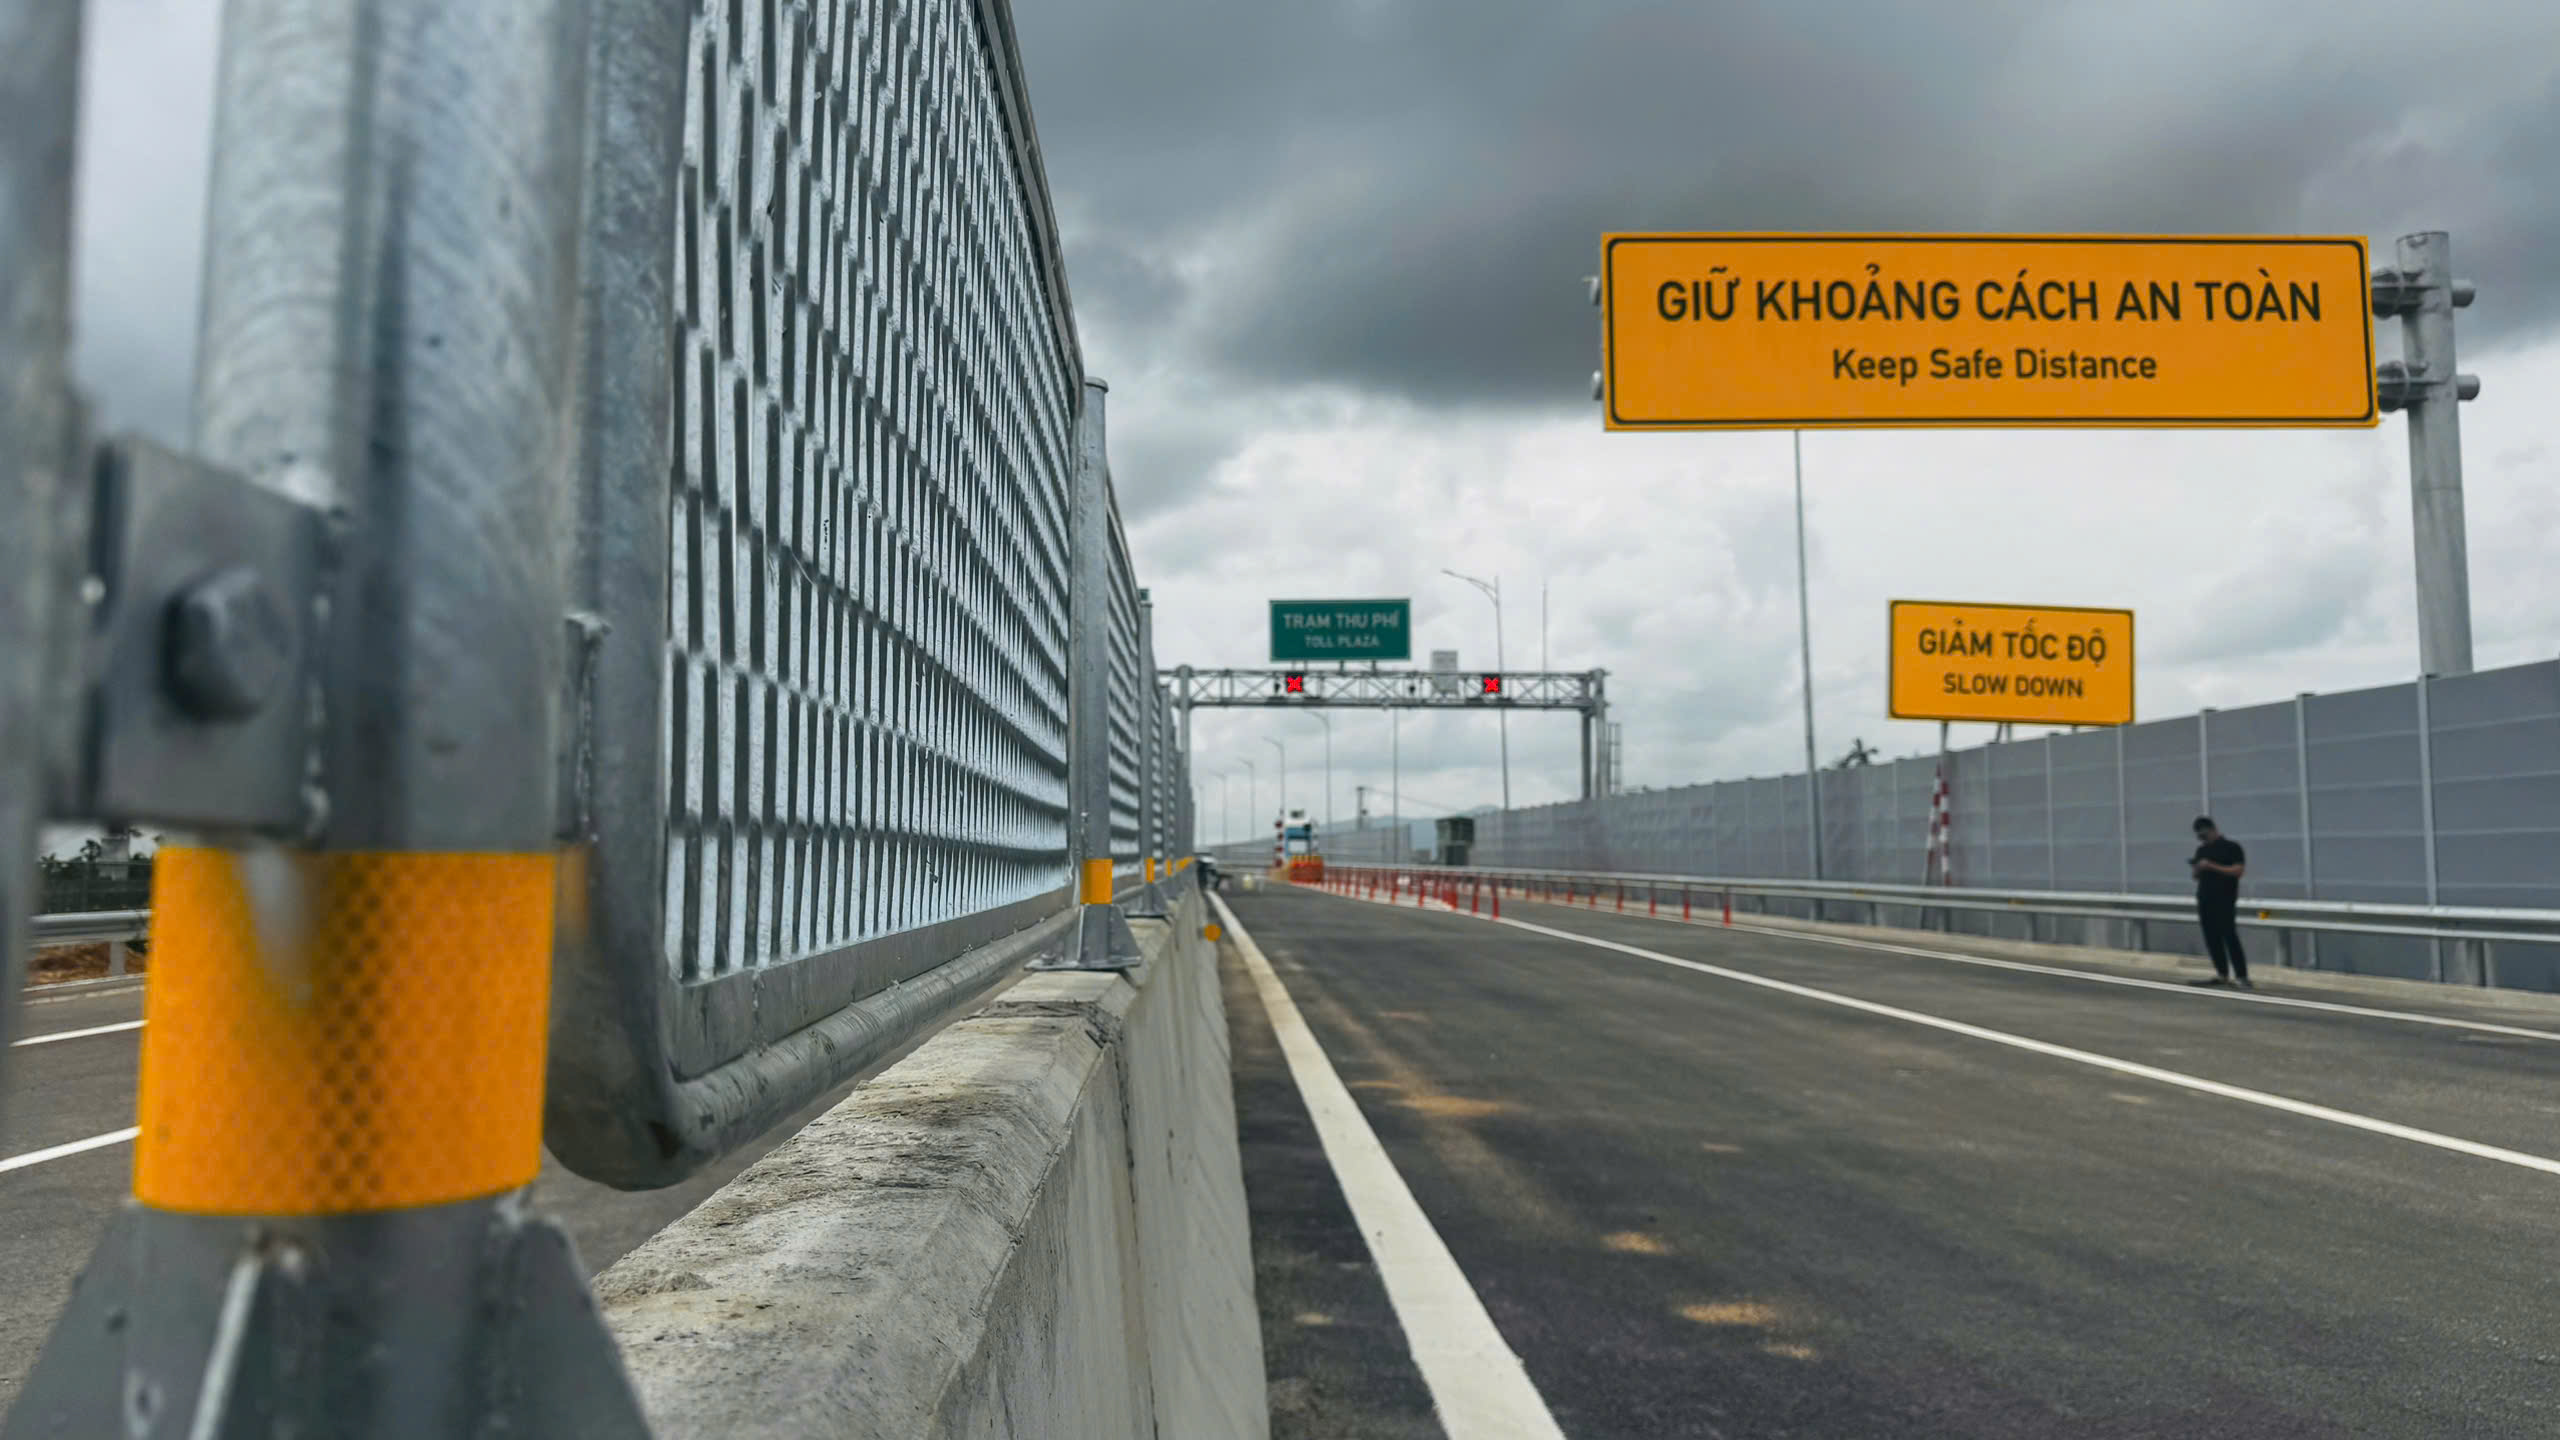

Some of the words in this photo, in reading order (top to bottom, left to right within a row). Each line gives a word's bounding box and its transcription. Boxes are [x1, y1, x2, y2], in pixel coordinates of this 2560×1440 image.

[1657, 265, 1741, 321] GIỮ
[1756, 262, 1960, 321] KHOẢNG
[1975, 268, 2099, 322] CÁCH
[2115, 280, 2182, 322] AN
[2195, 267, 2322, 322] TOÀN
[1833, 348, 1918, 387] Keep
[1929, 348, 2003, 380] Safe
[2016, 348, 2157, 380] Distance
[1336, 612, 1369, 629] THU
[1304, 634, 1334, 648] TOLL
[1337, 634, 1380, 648] PLAZA
[1918, 617, 1993, 657] GIẢM
[2003, 617, 2058, 660] TỐC
[2066, 627, 2107, 667] ĐỘ
[1943, 672, 2008, 695] SLOW
[2015, 675, 2084, 698] DOWN
